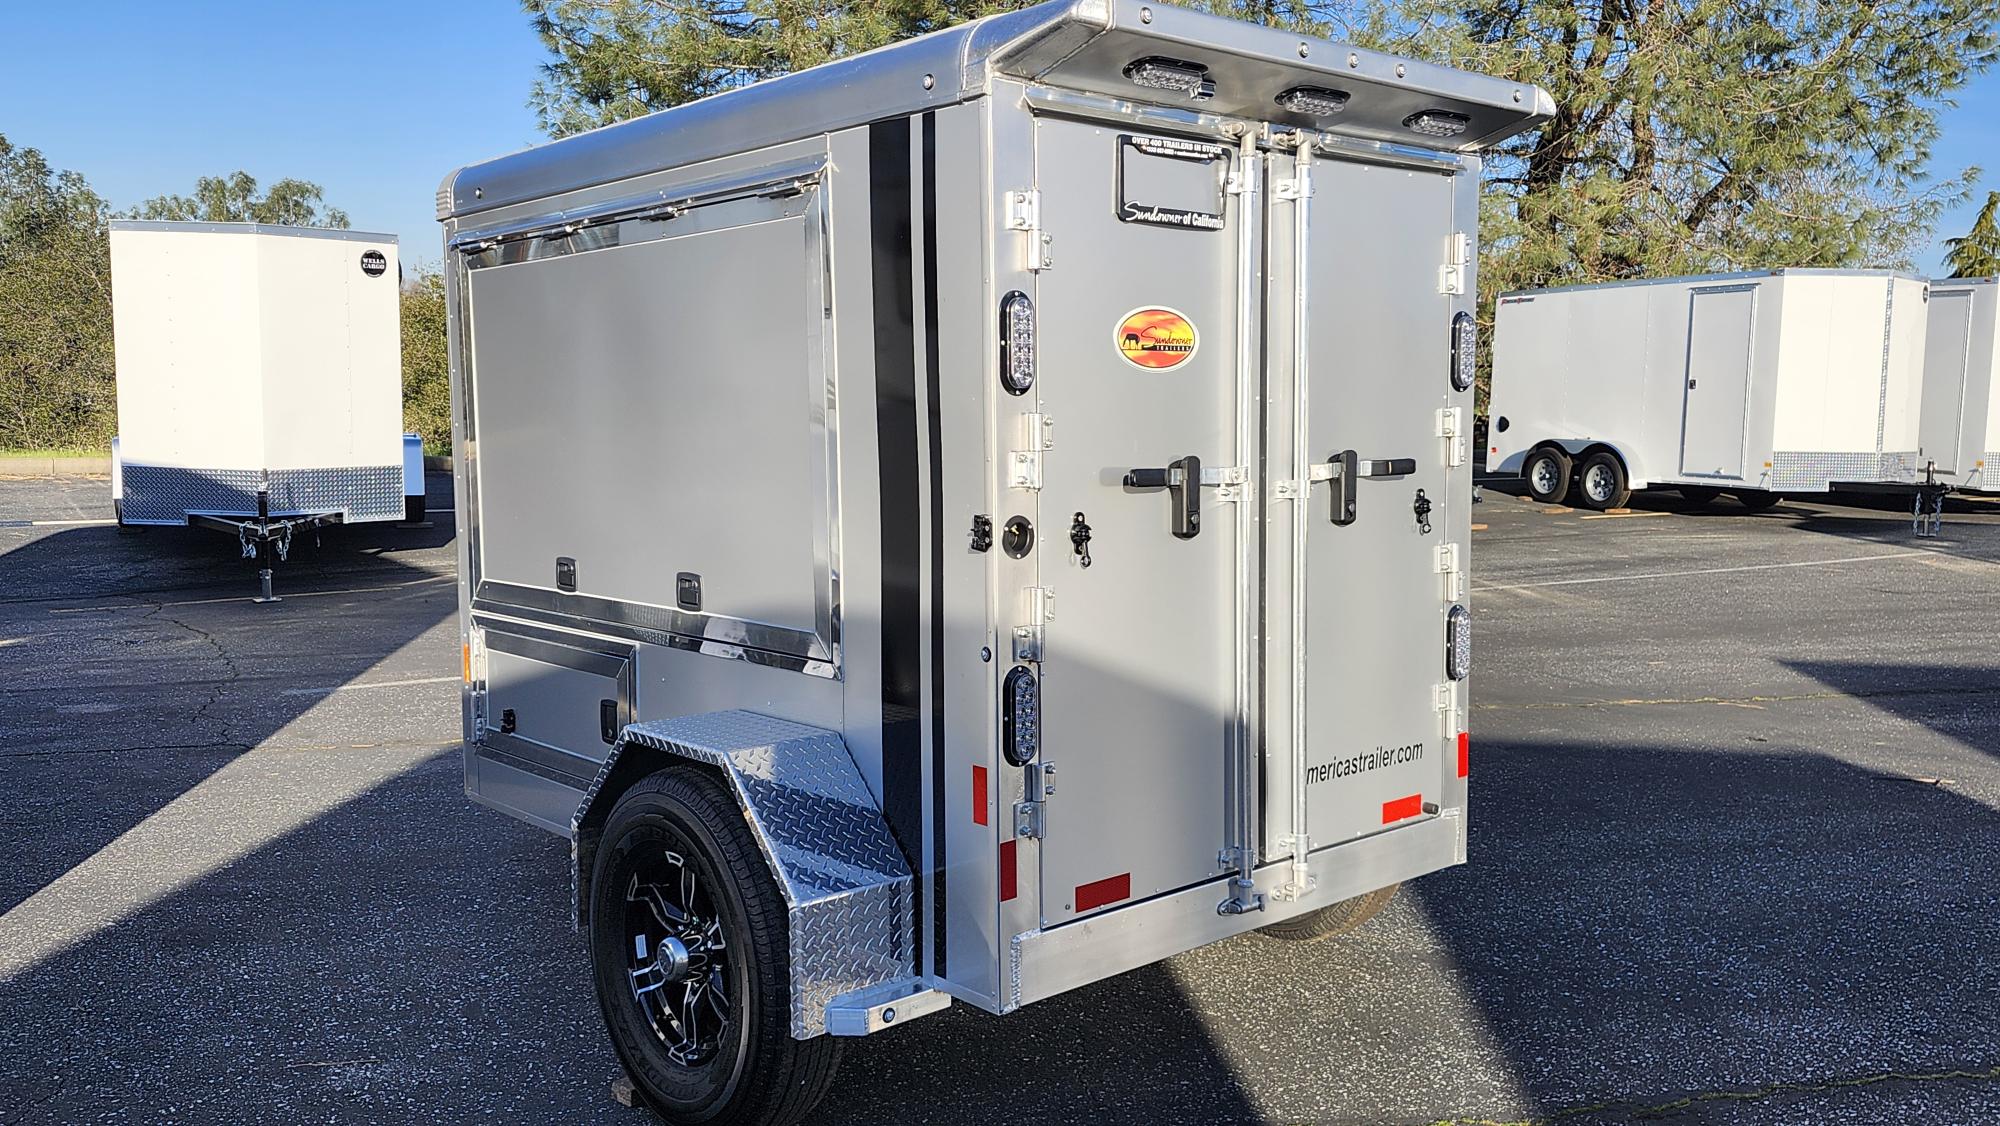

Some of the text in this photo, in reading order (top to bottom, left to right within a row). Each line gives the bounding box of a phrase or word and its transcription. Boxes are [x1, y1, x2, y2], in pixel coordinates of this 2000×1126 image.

[1132, 136, 1222, 154] OVER 400 TRAILERS IN STOCK
[1124, 200, 1224, 229] Sundowner of California
[1141, 325, 1193, 345] Sundowner
[1306, 742, 1423, 785] mericastrailer.com
